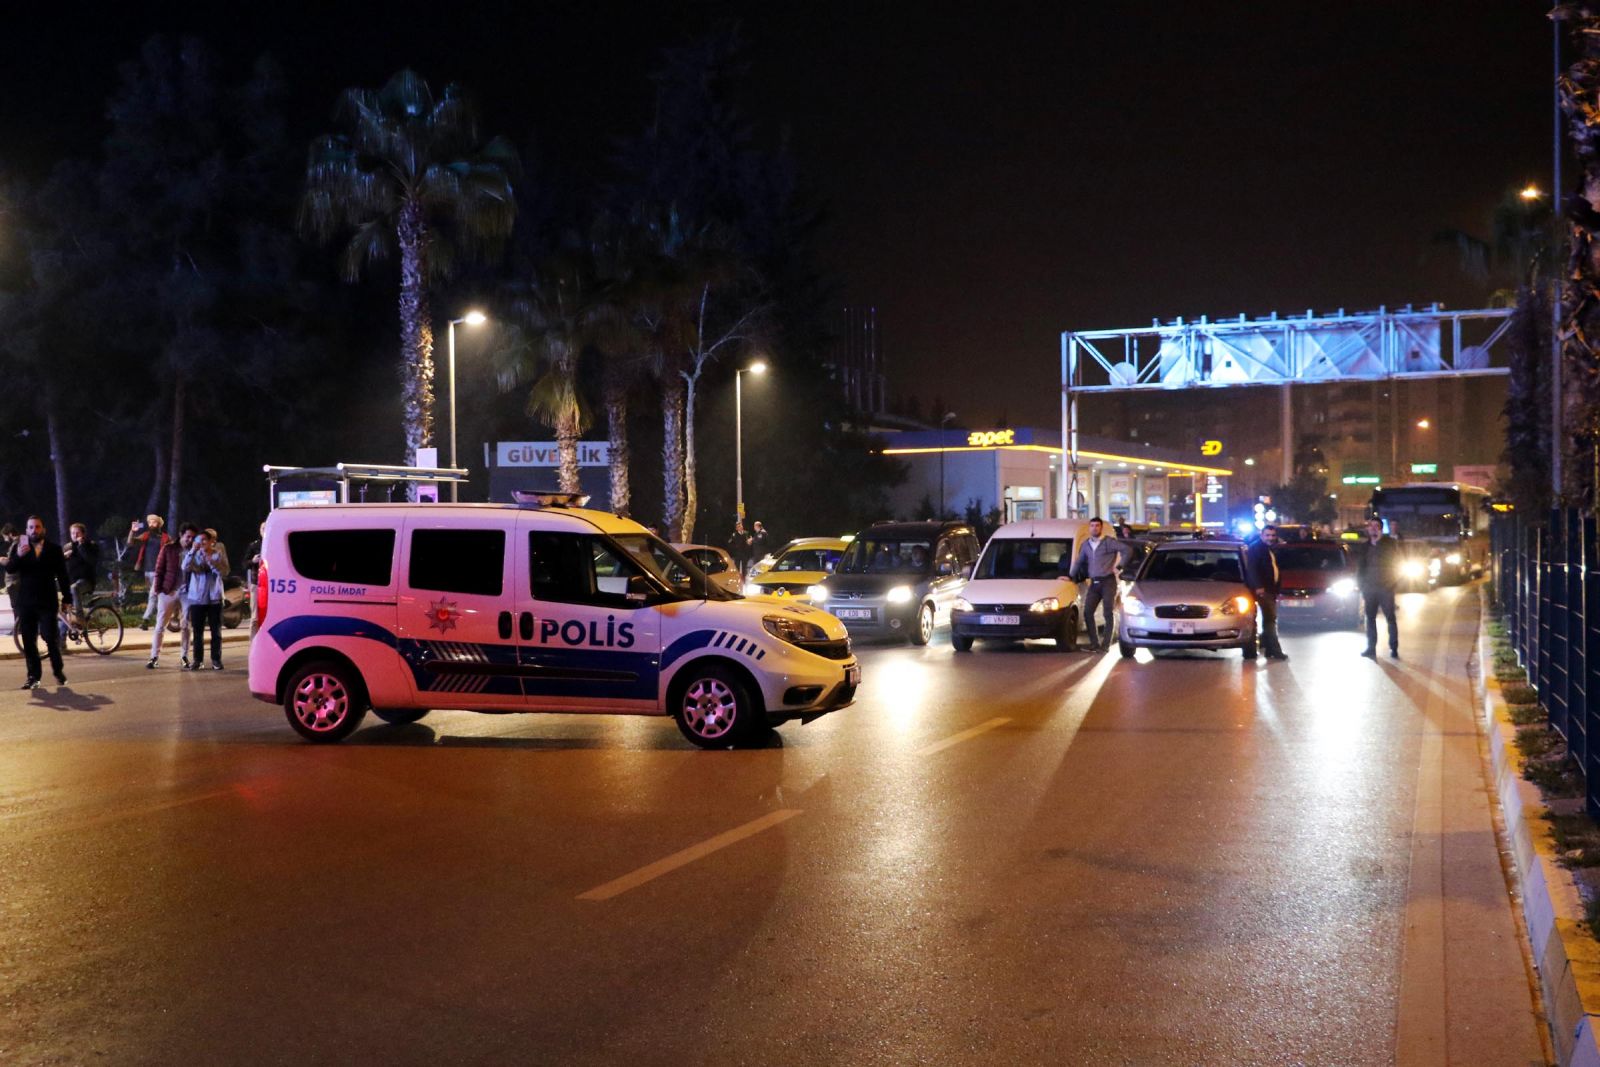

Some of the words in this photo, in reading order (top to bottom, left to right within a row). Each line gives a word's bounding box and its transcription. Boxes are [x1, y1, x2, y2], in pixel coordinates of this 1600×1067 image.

[967, 429, 1014, 447] opet
[507, 446, 601, 463] GÜVEİK
[269, 578, 297, 593] 155
[310, 584, 336, 595] POLİS
[338, 585, 367, 596] İMDAT
[540, 614, 635, 648] POLİS
